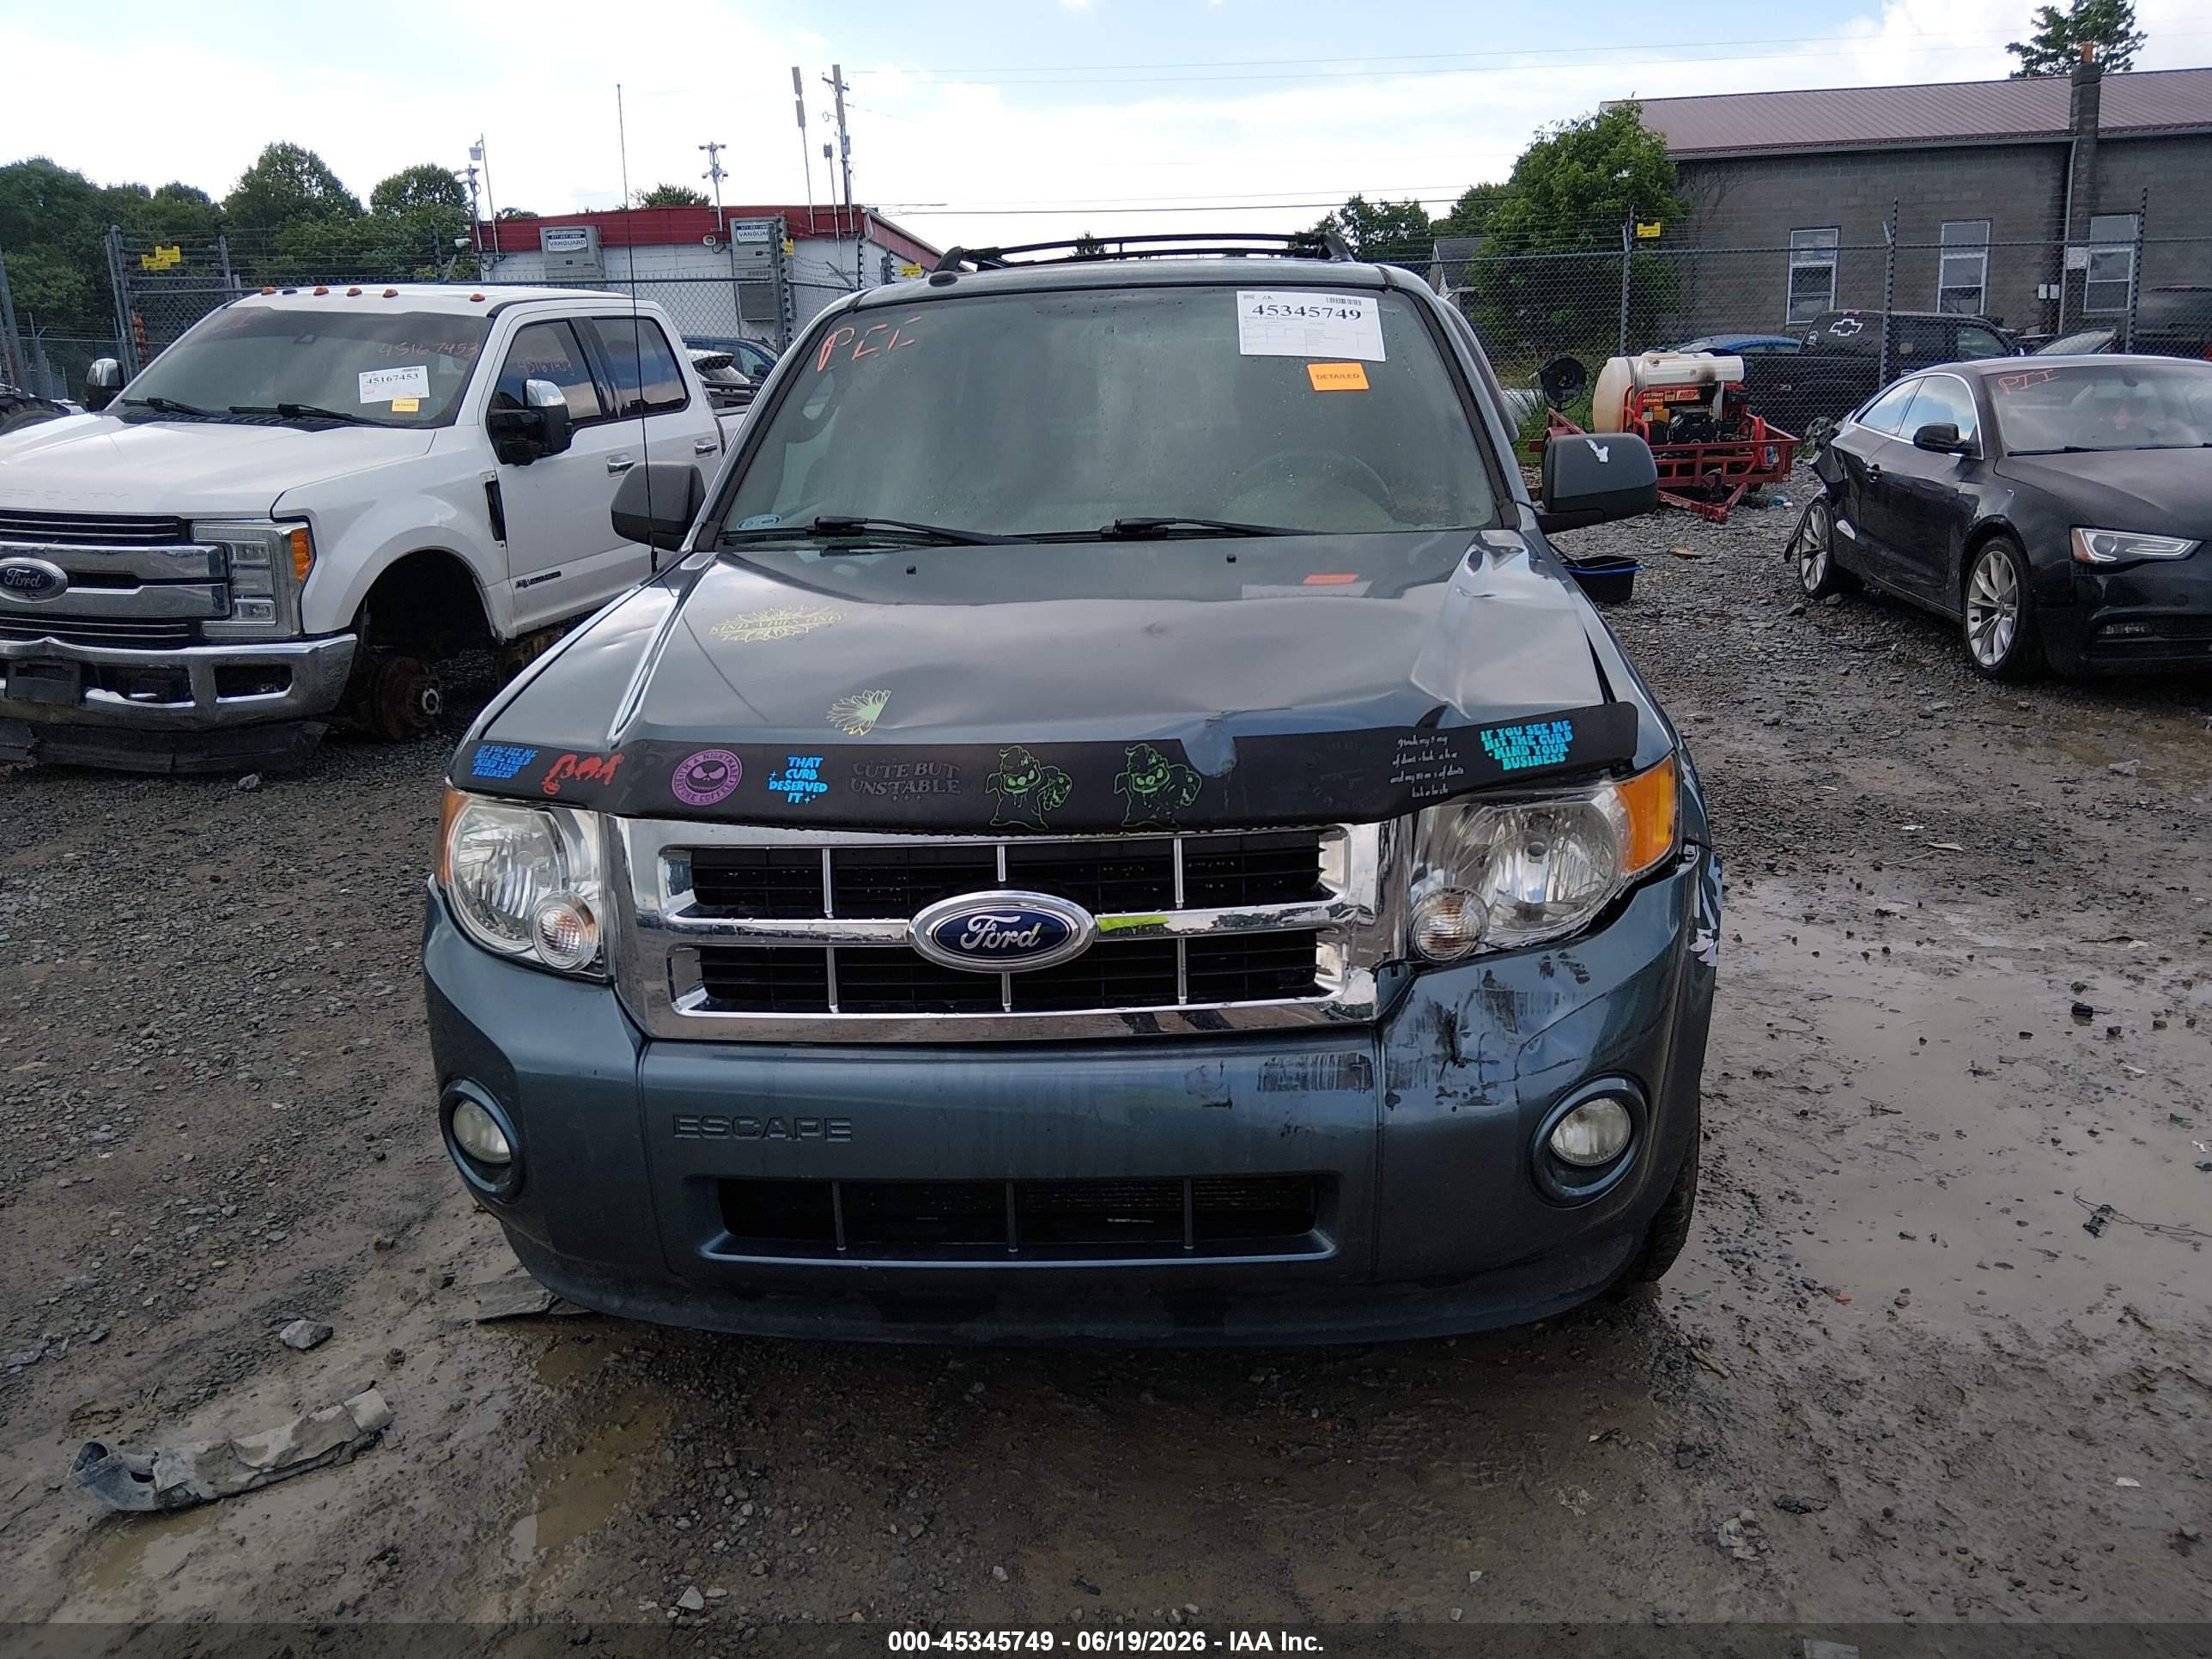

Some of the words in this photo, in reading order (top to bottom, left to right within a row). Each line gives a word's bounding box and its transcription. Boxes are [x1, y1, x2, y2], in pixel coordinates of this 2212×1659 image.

[1252, 303, 1362, 321] 45345749
[366, 373, 419, 385] 45167453
[3, 568, 42, 588] Ford
[1480, 730, 1494, 742] IF
[1496, 726, 1522, 738] YOU
[1525, 723, 1550, 735] SEE
[1552, 720, 1572, 733] ME
[1483, 736, 1509, 751] HIT
[1510, 735, 1537, 746] THE
[1539, 731, 1573, 744] CURB
[1494, 745, 1531, 760] MIND
[1533, 743, 1570, 756] YOUR
[787, 757, 824, 768] THAT
[1501, 752, 1566, 770] BUSINESS
[785, 769, 818, 780] CURB
[853, 762, 910, 778] CUTE
[914, 762, 961, 779] BUT
[769, 781, 829, 793] DESERVED
[851, 777, 962, 795] UNSTABLE
[787, 793, 804, 804] IT
[960, 915, 1042, 950] Ford
[673, 1115, 853, 1142] ESCAPE
